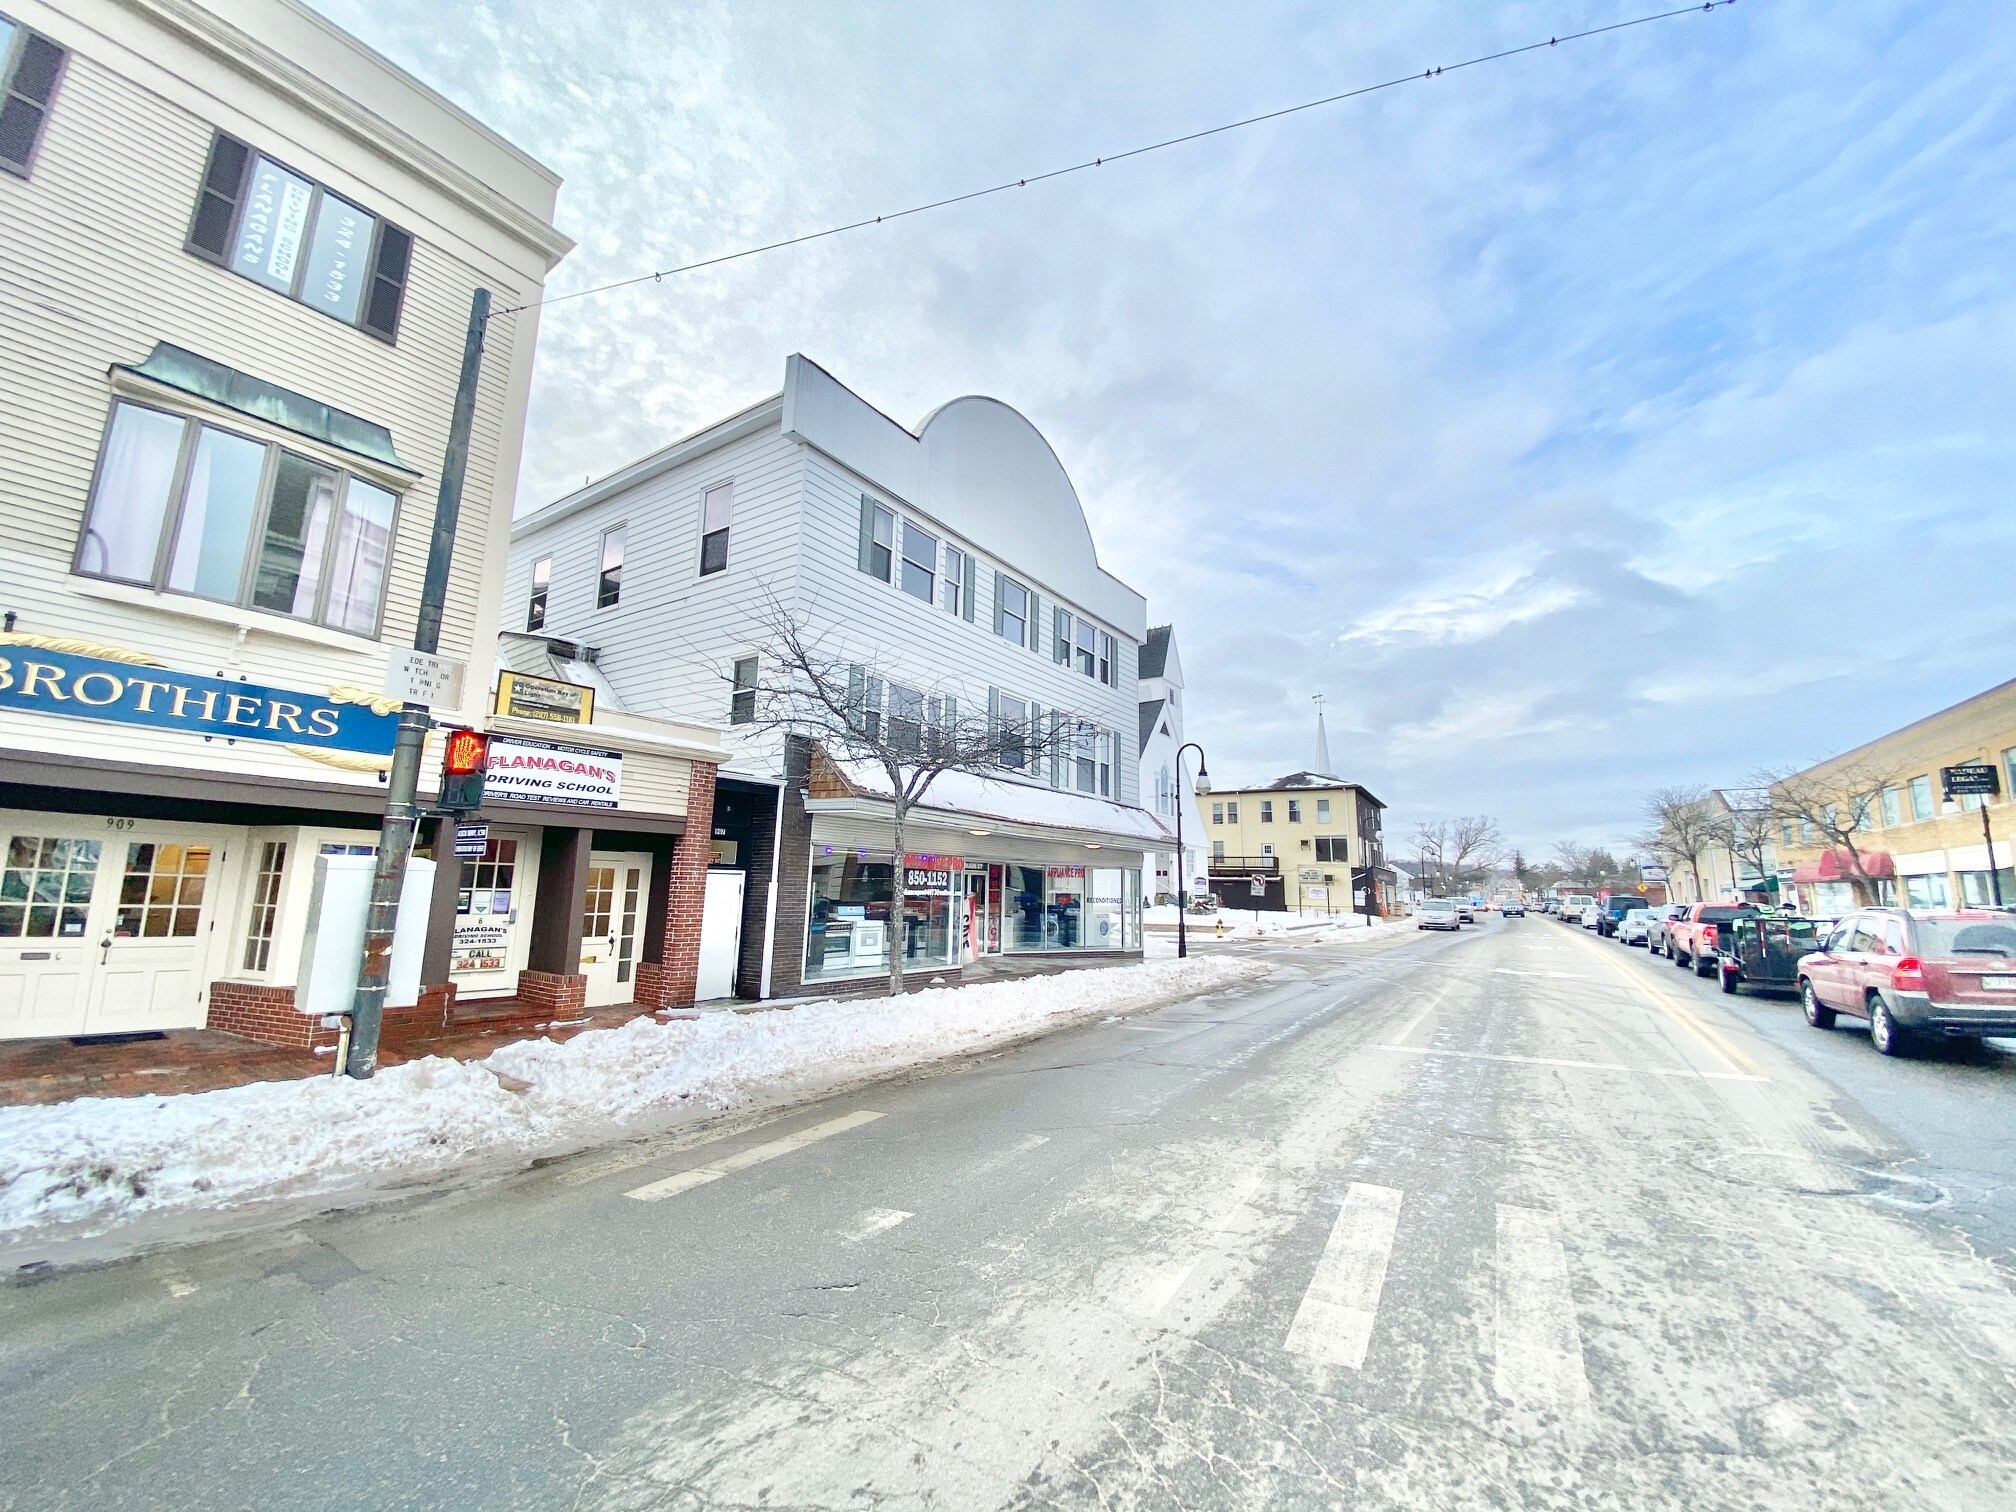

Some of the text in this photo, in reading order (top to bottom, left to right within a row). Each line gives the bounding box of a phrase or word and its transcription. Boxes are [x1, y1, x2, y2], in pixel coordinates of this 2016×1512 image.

[324, 216, 357, 302] 324-1533
[403, 665, 428, 676] WTCH
[411, 677, 441, 689] TRNIG
[524, 690, 541, 698] Light
[502, 737, 522, 745] DRIVER
[522, 739, 551, 750] EDUCATION
[486, 755, 616, 783] FLANAGAN'S
[486, 774, 614, 795] DRIVING SCHOOL
[543, 796, 567, 804] REVIEWS
[591, 800, 613, 808] RENTALS
[107, 817, 135, 830] 909
[907, 869, 948, 887] 850-1152
[454, 926, 507, 934] LANAGAN'S
[468, 949, 492, 958] CALL
[456, 958, 501, 970] 324 1533
